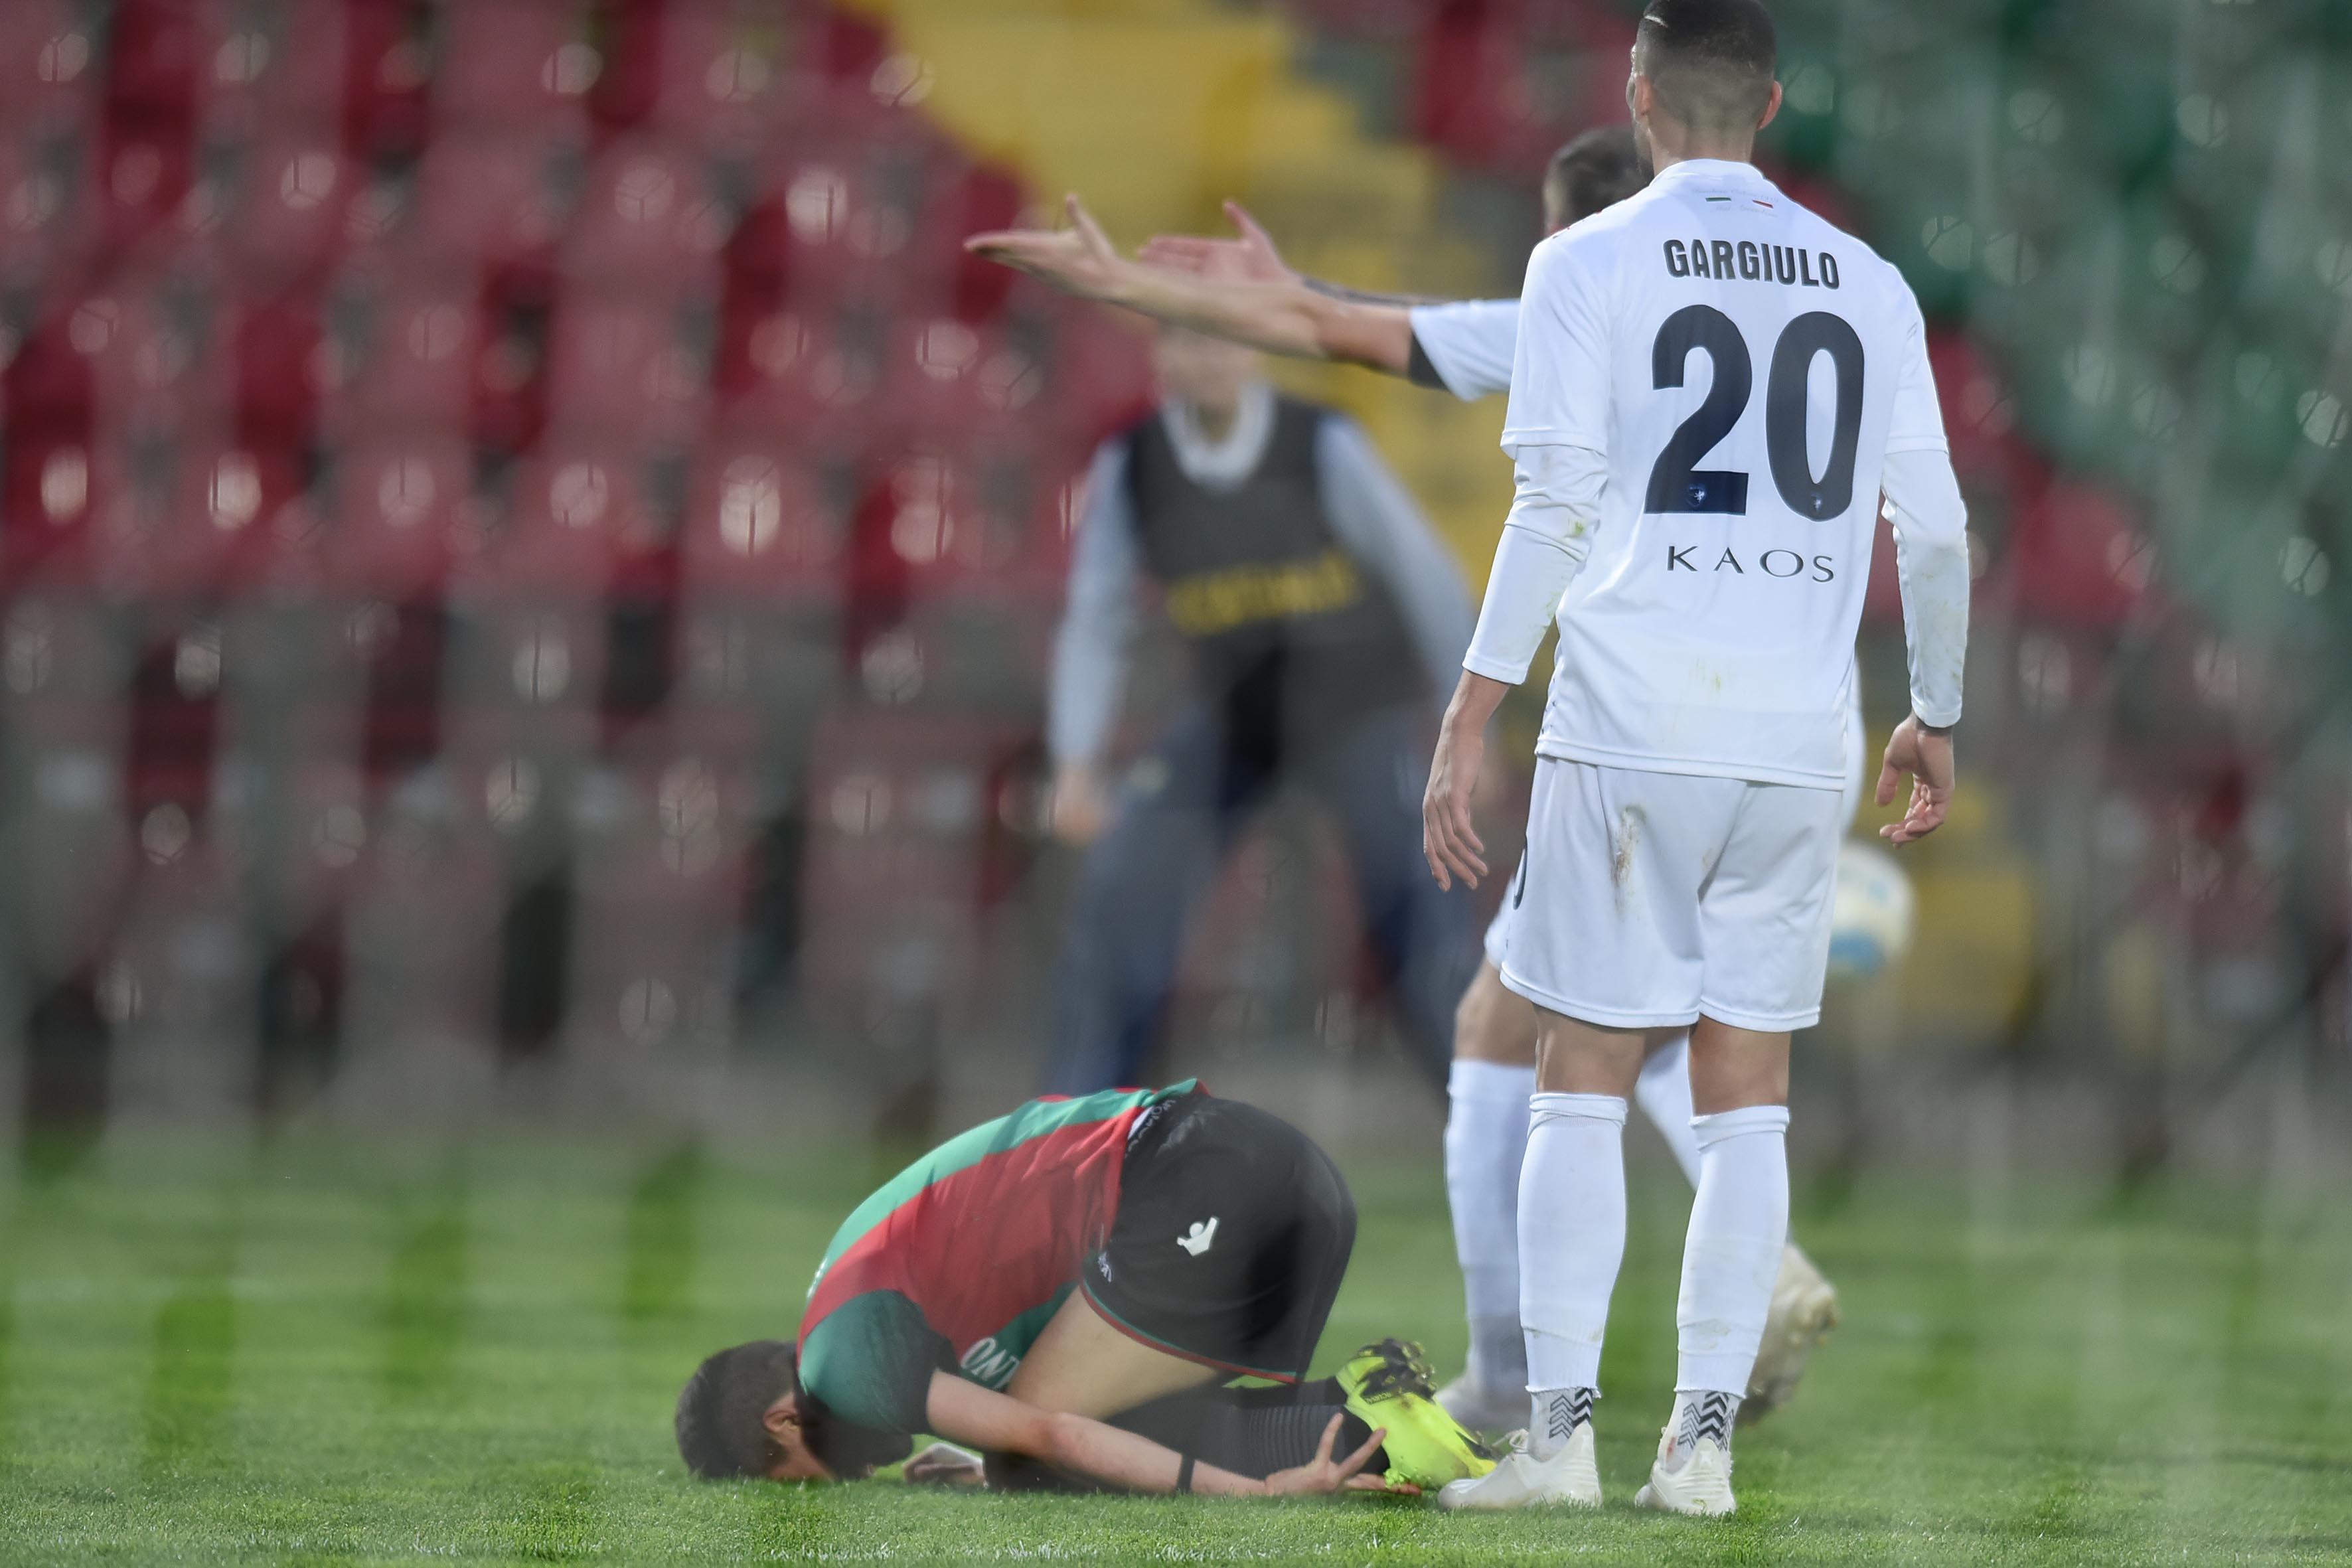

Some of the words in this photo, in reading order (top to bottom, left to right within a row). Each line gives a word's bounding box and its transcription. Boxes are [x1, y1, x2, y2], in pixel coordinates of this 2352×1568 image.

[1663, 239, 1840, 289] GARGIULO
[1644, 304, 1865, 522] 20
[1667, 545, 1834, 583] KAOS
